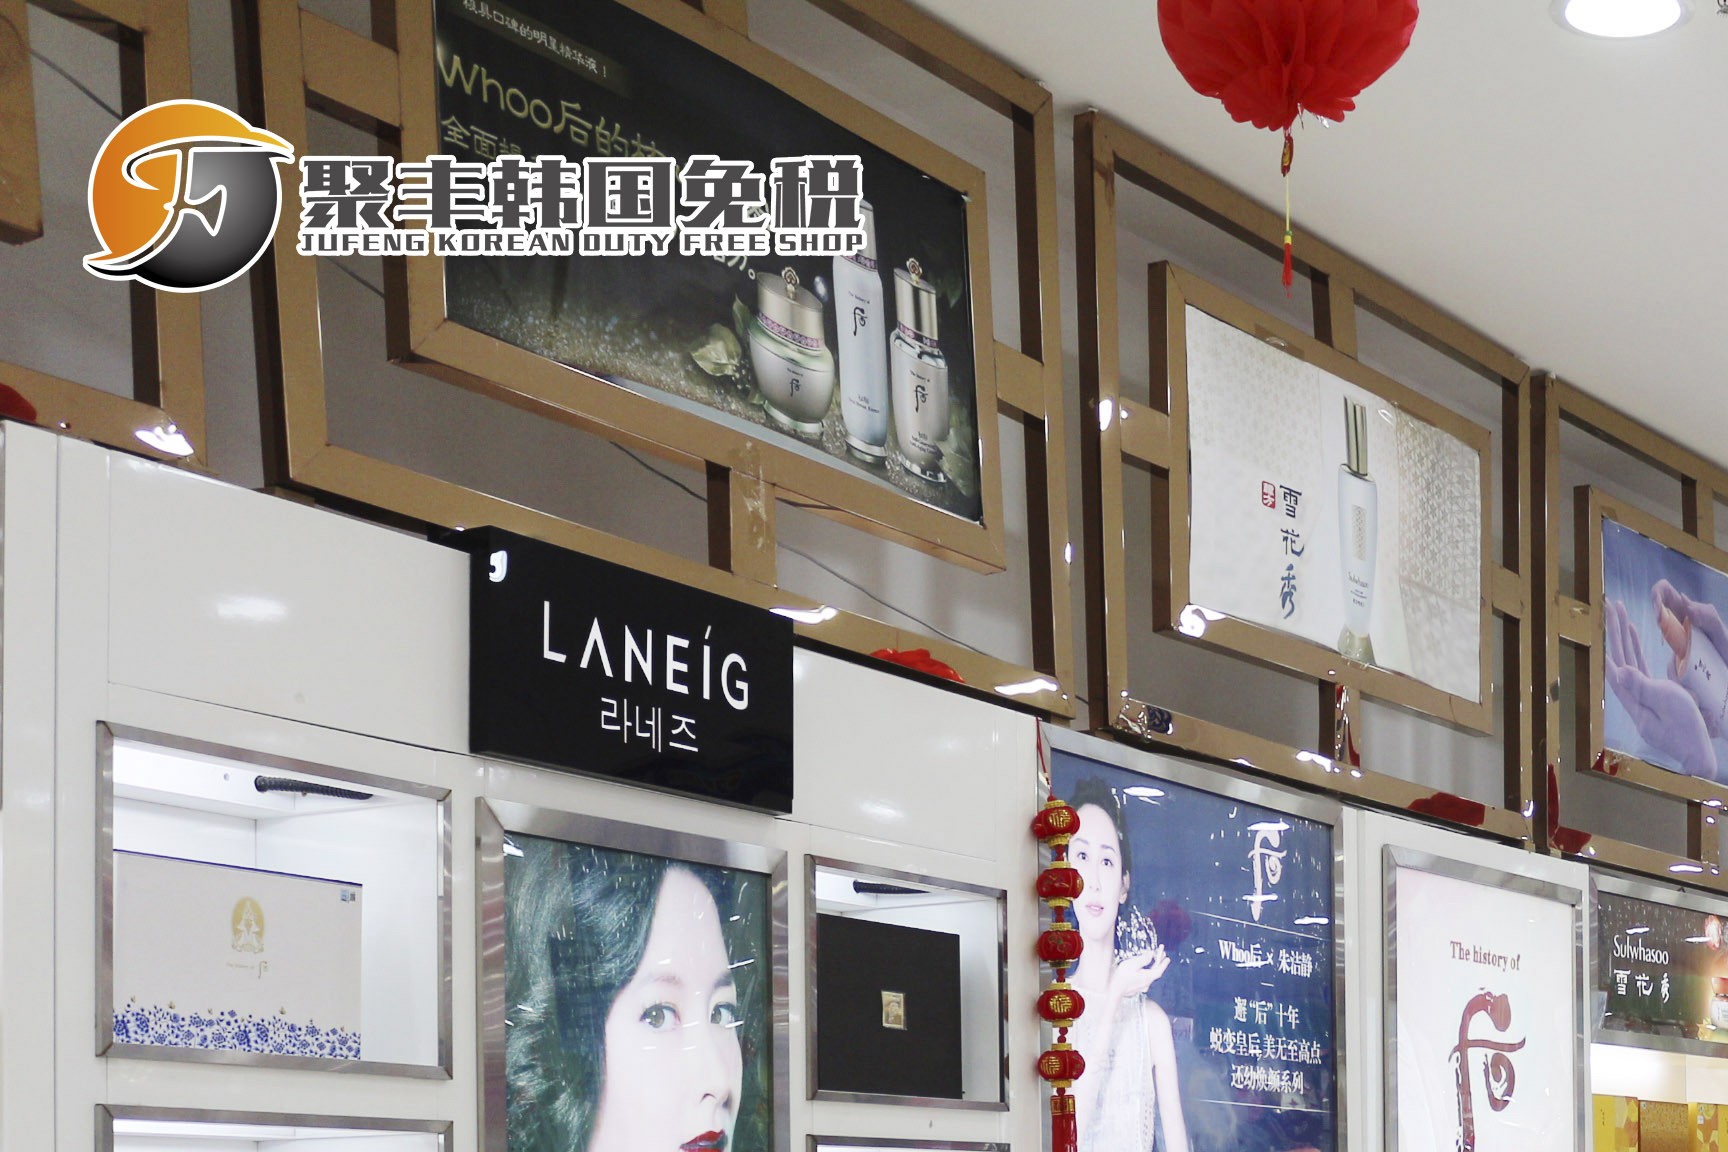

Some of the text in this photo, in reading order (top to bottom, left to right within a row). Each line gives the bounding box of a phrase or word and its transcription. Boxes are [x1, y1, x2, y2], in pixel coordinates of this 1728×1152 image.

[601, 696, 699, 753] 라네즈
[1278, 948, 1313, 979] 朱洁静
[1450, 940, 1521, 973] The history of
[1613, 934, 1670, 967] Sulwhasoo
[1613, 968, 1671, 1005] 雪花秀
